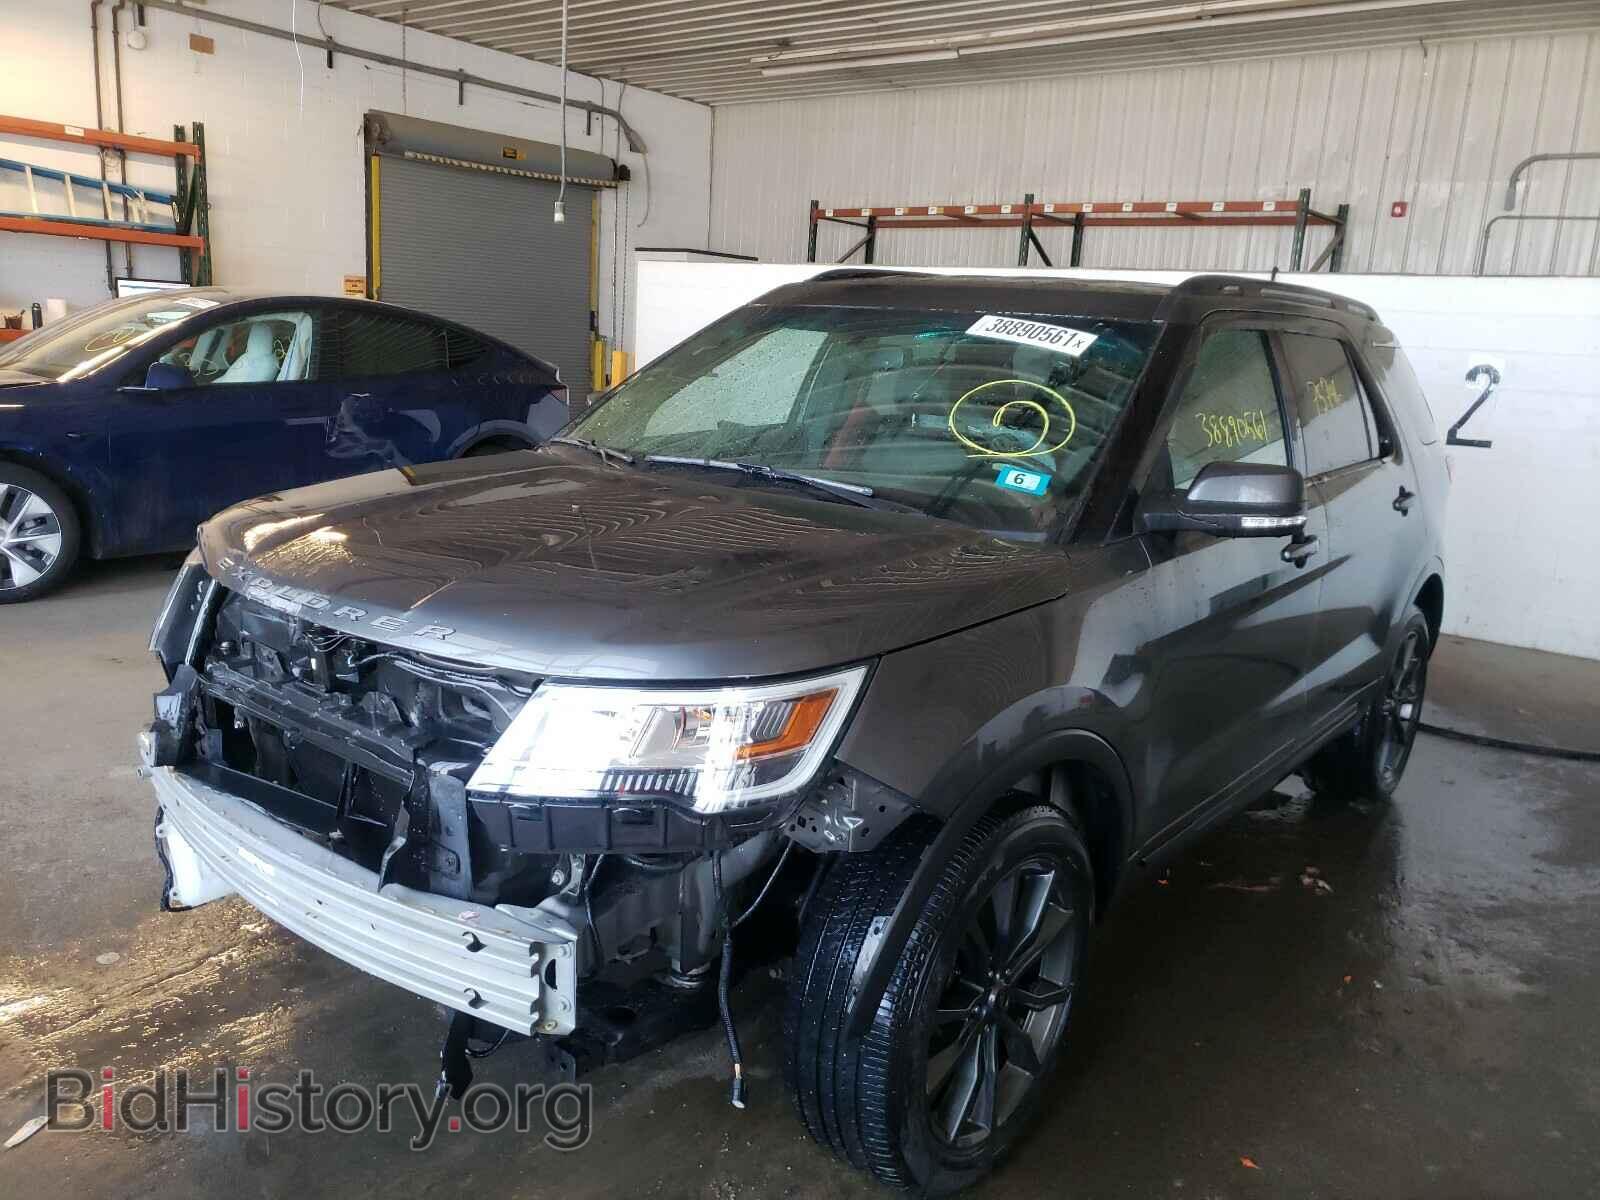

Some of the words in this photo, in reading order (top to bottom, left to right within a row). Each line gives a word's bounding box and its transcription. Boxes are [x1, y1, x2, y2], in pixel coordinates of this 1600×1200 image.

[1445, 364, 1501, 449] 2
[1013, 473, 1027, 485] 6
[216, 556, 458, 641] EXPLORER
